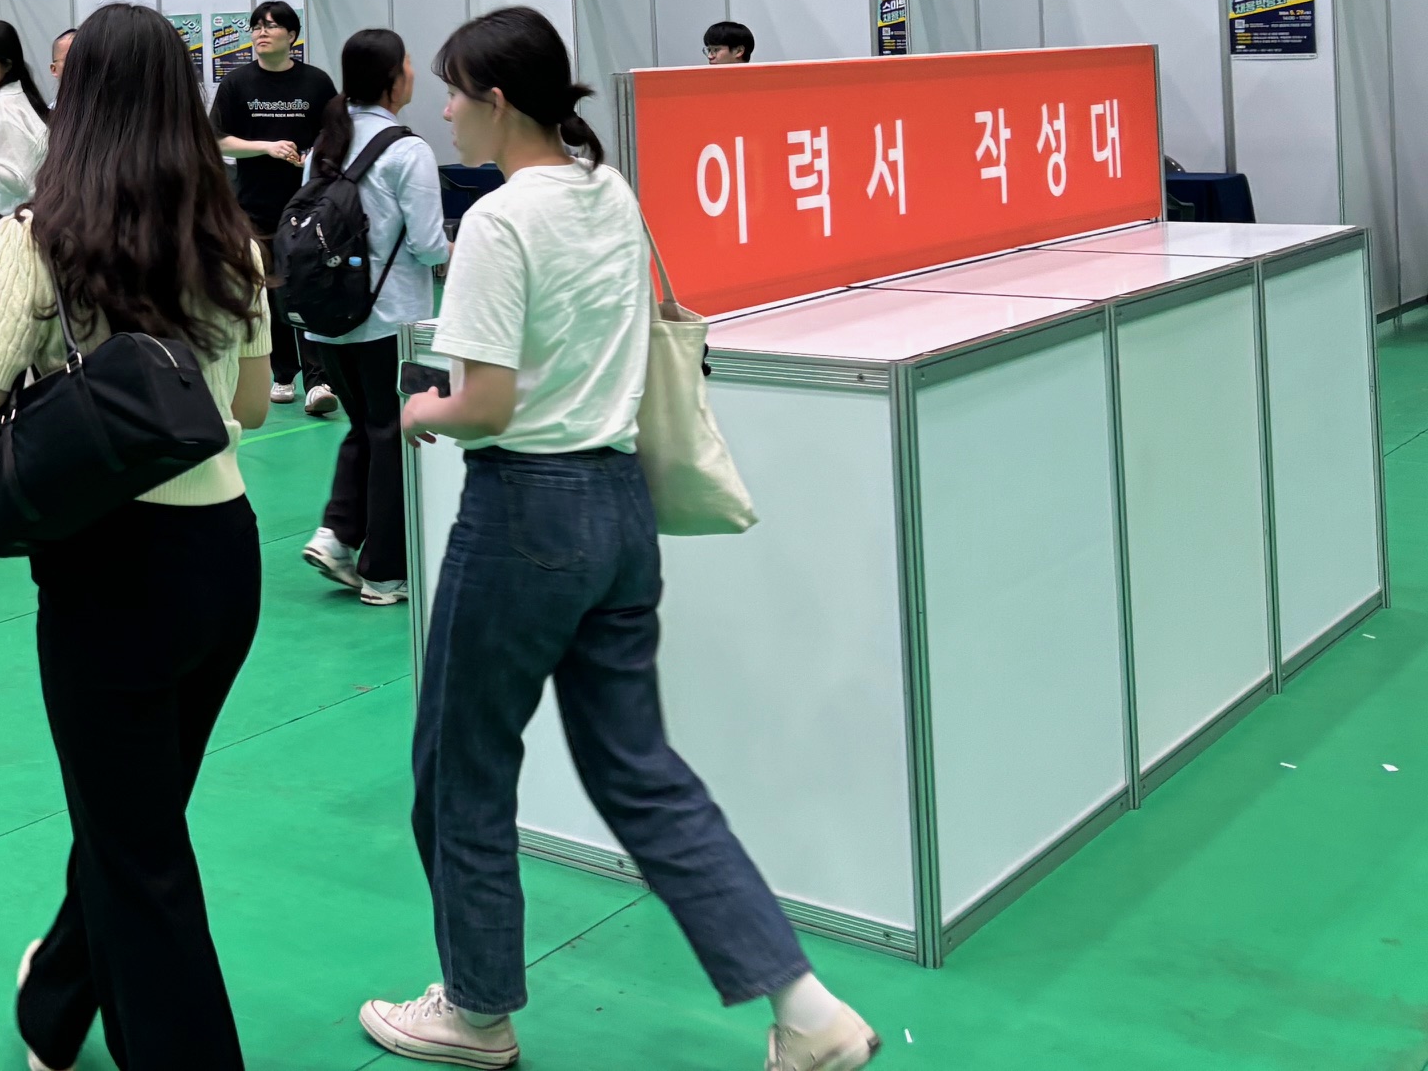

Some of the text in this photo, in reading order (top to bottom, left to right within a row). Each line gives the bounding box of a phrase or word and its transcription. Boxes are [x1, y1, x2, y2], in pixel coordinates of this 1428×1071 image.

[246, 98, 310, 111] vivastudio
[696, 97, 1122, 245] 이력서 작성대
